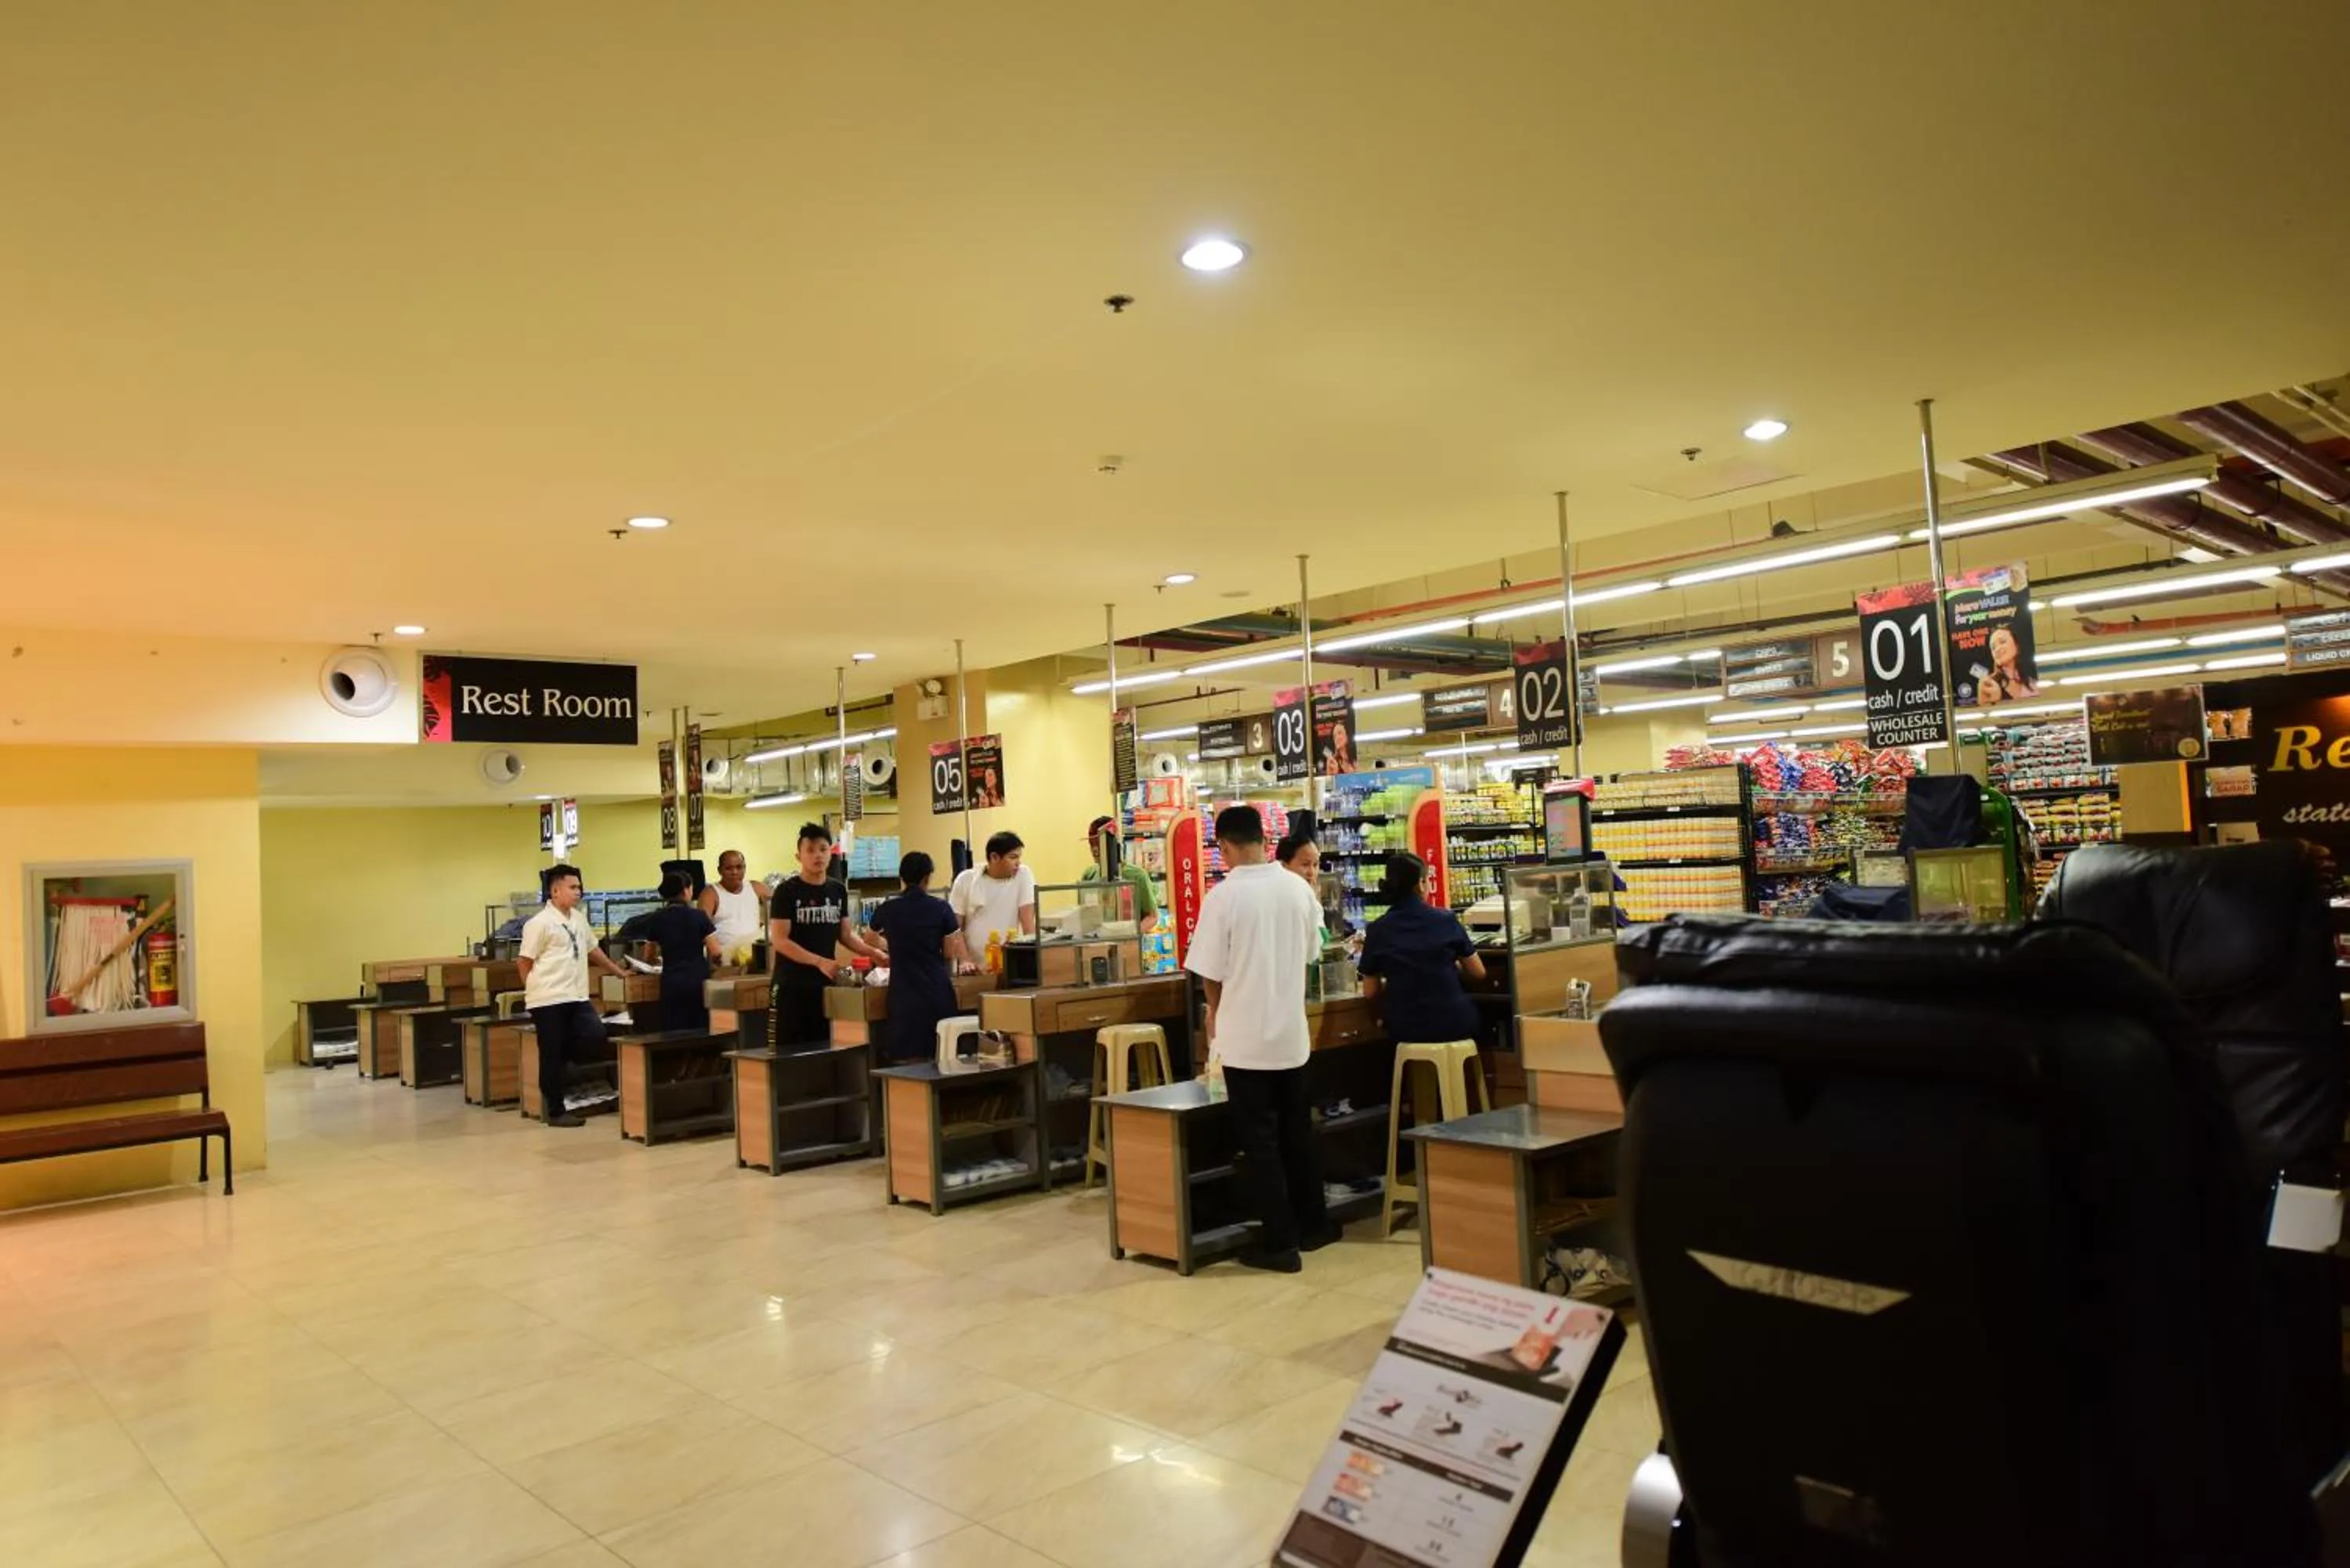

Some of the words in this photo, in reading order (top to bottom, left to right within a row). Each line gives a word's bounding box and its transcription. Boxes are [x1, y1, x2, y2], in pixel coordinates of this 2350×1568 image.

[1832, 641, 1849, 677] 5
[1870, 613, 1932, 681] 01
[461, 685, 532, 717] Rest
[543, 688, 632, 719] Room
[1499, 688, 1513, 718] 4
[1521, 667, 1564, 721] 02
[1868, 688, 1893, 710] cash
[1905, 683, 1939, 706] credit
[1253, 722, 1263, 748] 3
[1278, 708, 1304, 756] 03
[1520, 729, 1538, 746] cash
[1870, 712, 1943, 733] WHOLESALE
[1877, 727, 1939, 745] COUNTER
[935, 757, 961, 794] 05
[690, 793, 702, 822] 07
[1182, 858, 1193, 912] ORAL
